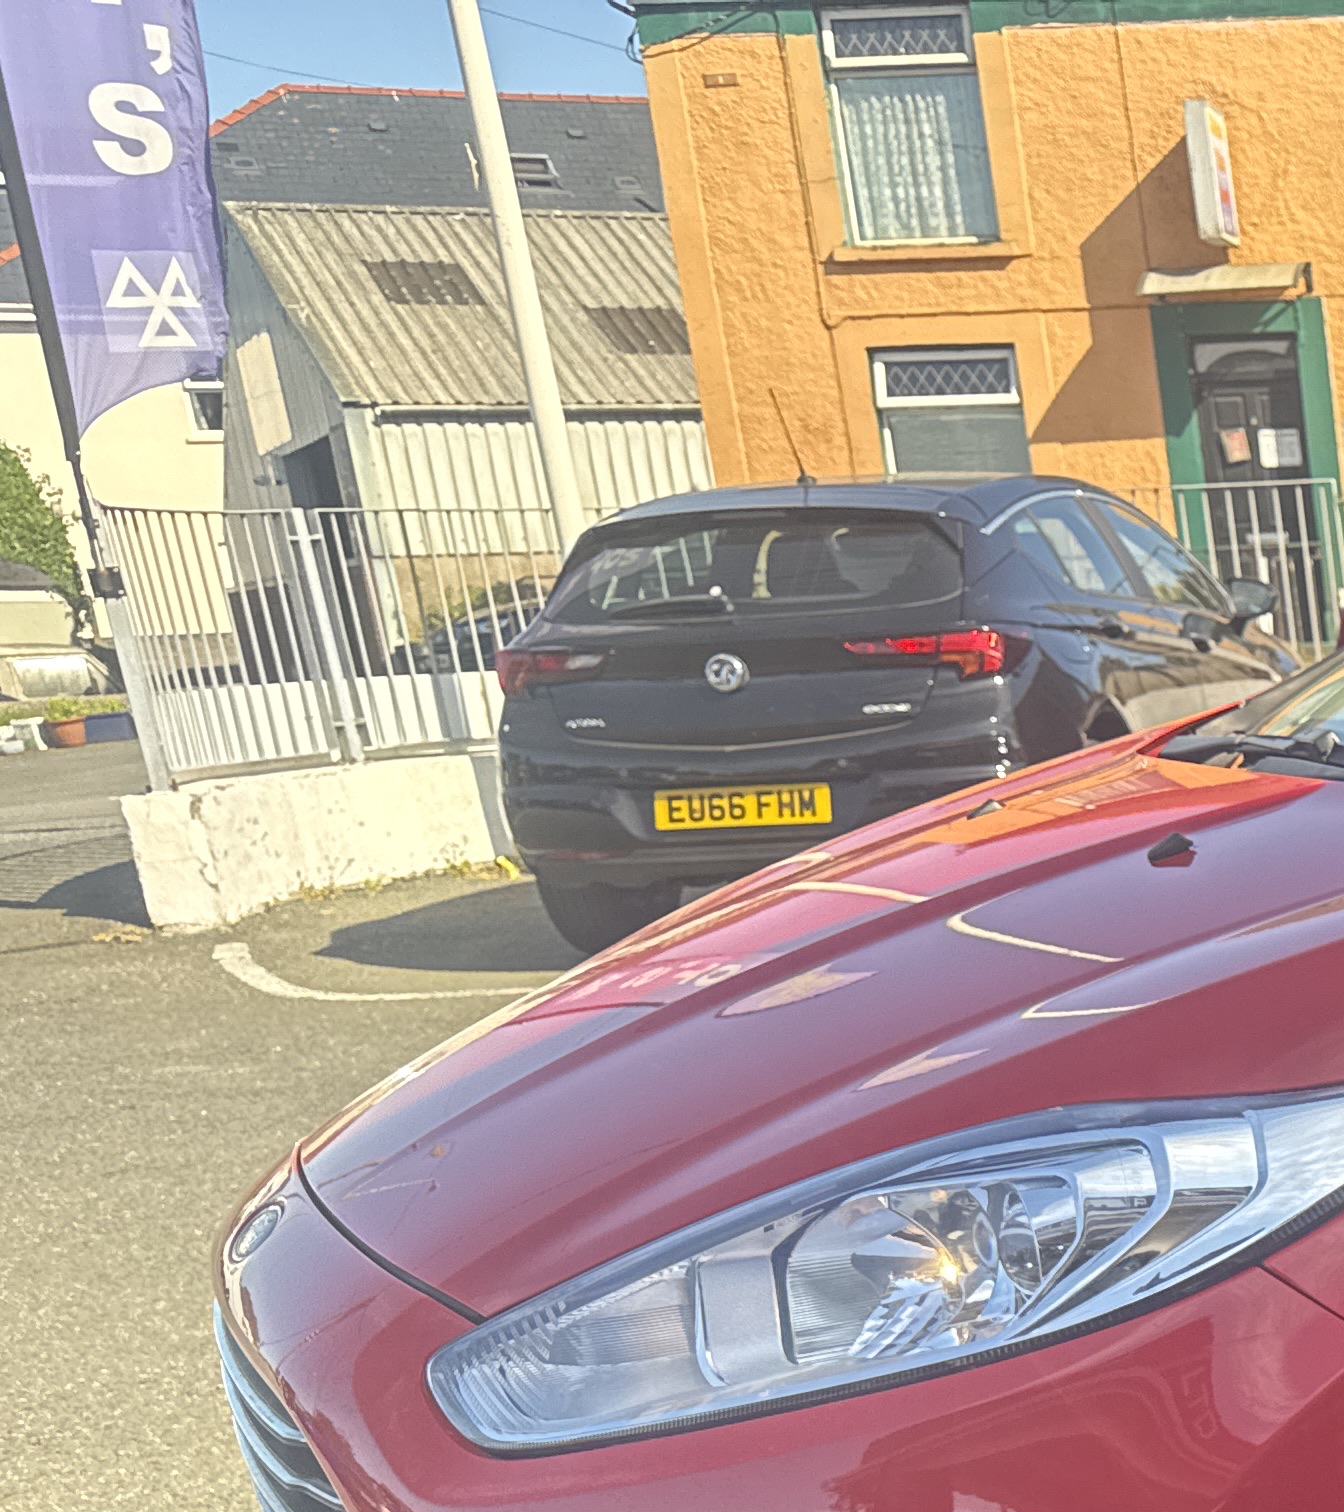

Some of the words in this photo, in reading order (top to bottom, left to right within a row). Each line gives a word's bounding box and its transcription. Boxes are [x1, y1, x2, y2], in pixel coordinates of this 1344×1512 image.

[87, 0, 173, 176] 'S
[667, 792, 746, 823] EU66
[755, 788, 818, 819] FHM
